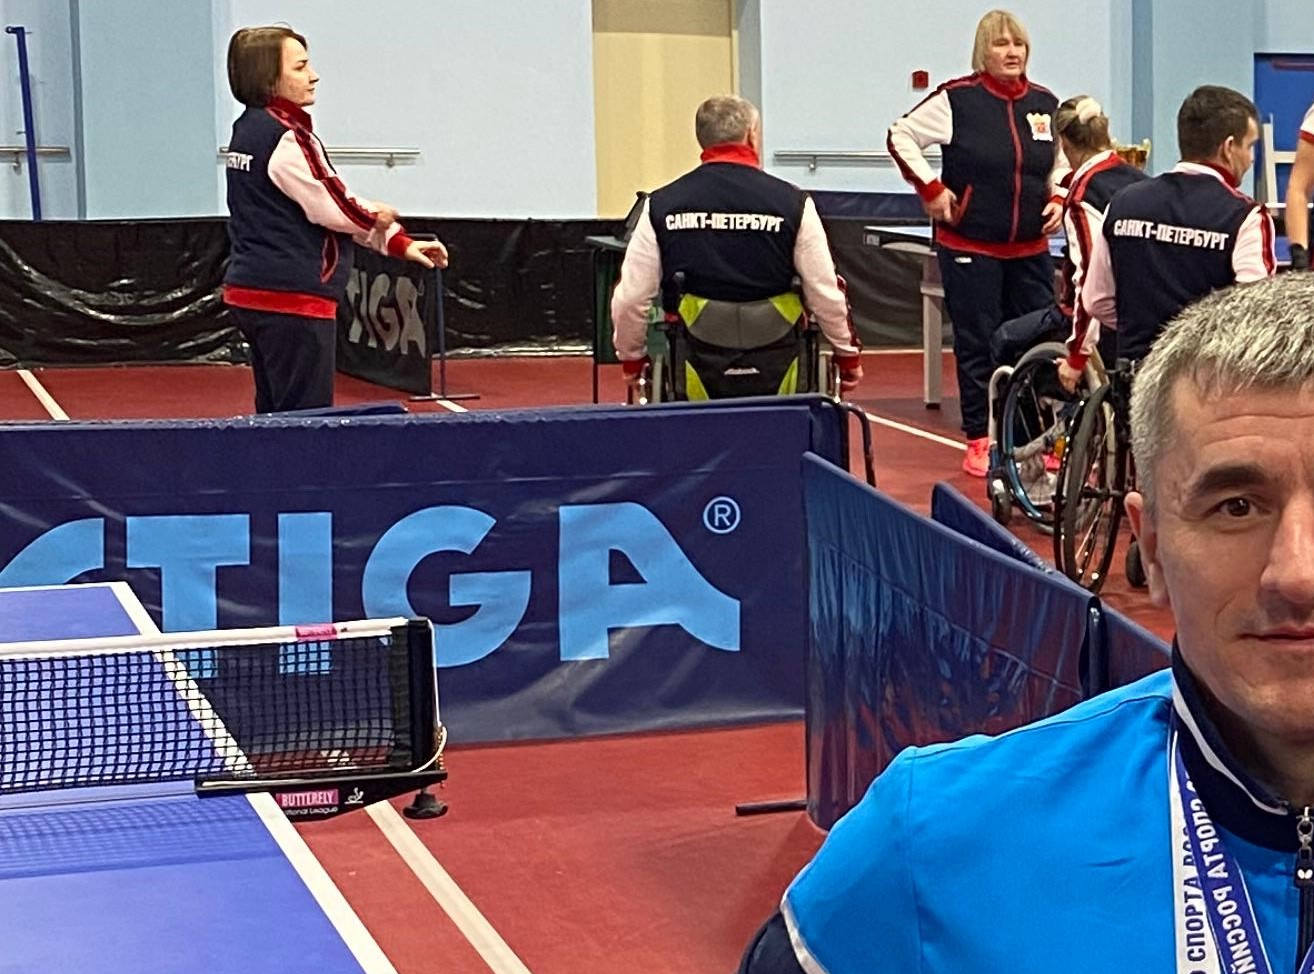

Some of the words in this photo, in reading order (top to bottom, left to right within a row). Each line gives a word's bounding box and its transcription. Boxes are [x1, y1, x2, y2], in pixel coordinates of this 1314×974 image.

[665, 212, 785, 233] САНКТ-ПЕТЕРБУРГ
[1113, 218, 1230, 250] САНКТ-ПЕТЕРБУРГ
[281, 790, 335, 808] BUTTERFLY
[1183, 875, 1207, 963] СПОРТА
